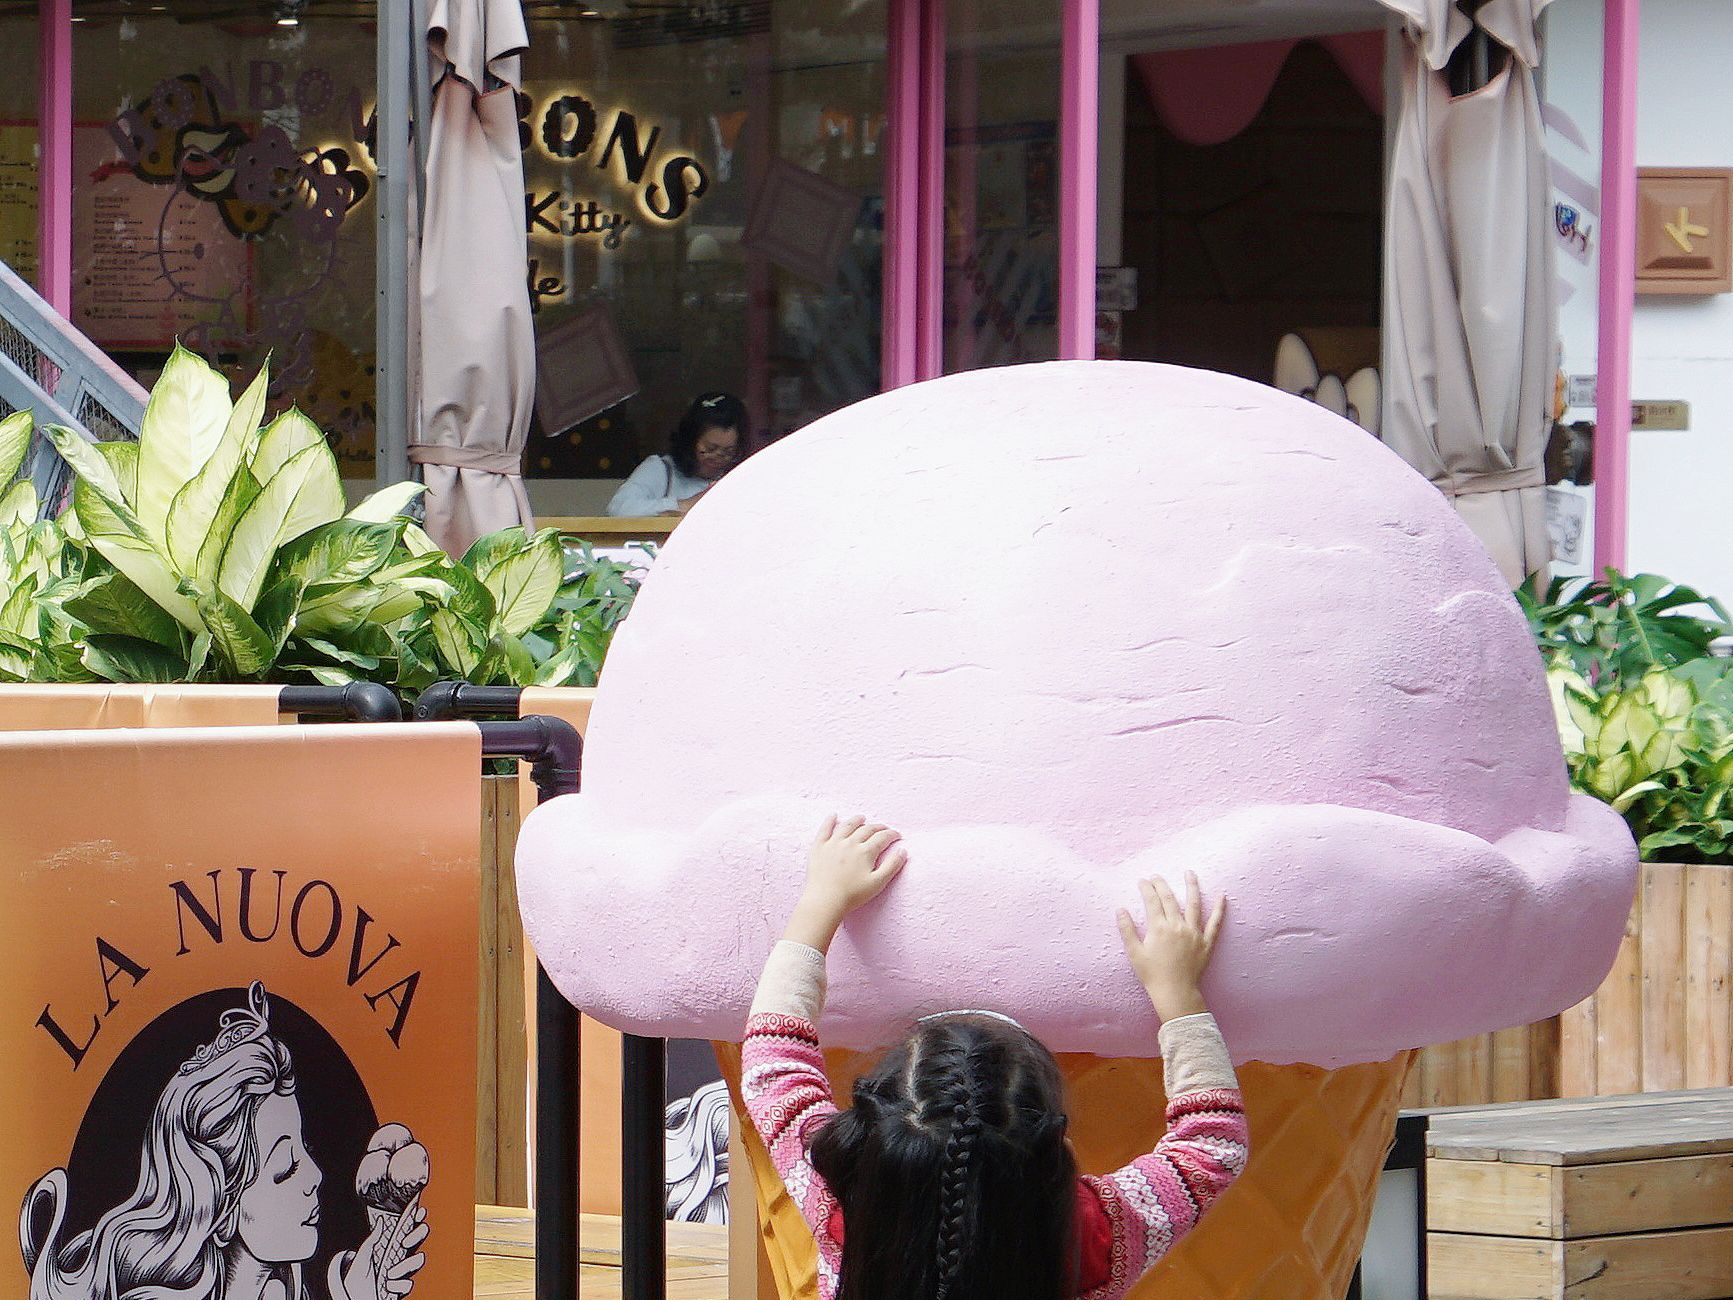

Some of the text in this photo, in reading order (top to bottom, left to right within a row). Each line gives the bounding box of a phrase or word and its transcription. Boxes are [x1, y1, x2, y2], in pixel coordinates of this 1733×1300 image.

[526, 191, 631, 250] Kitty
[35, 867, 422, 1072] LA NUOVA
